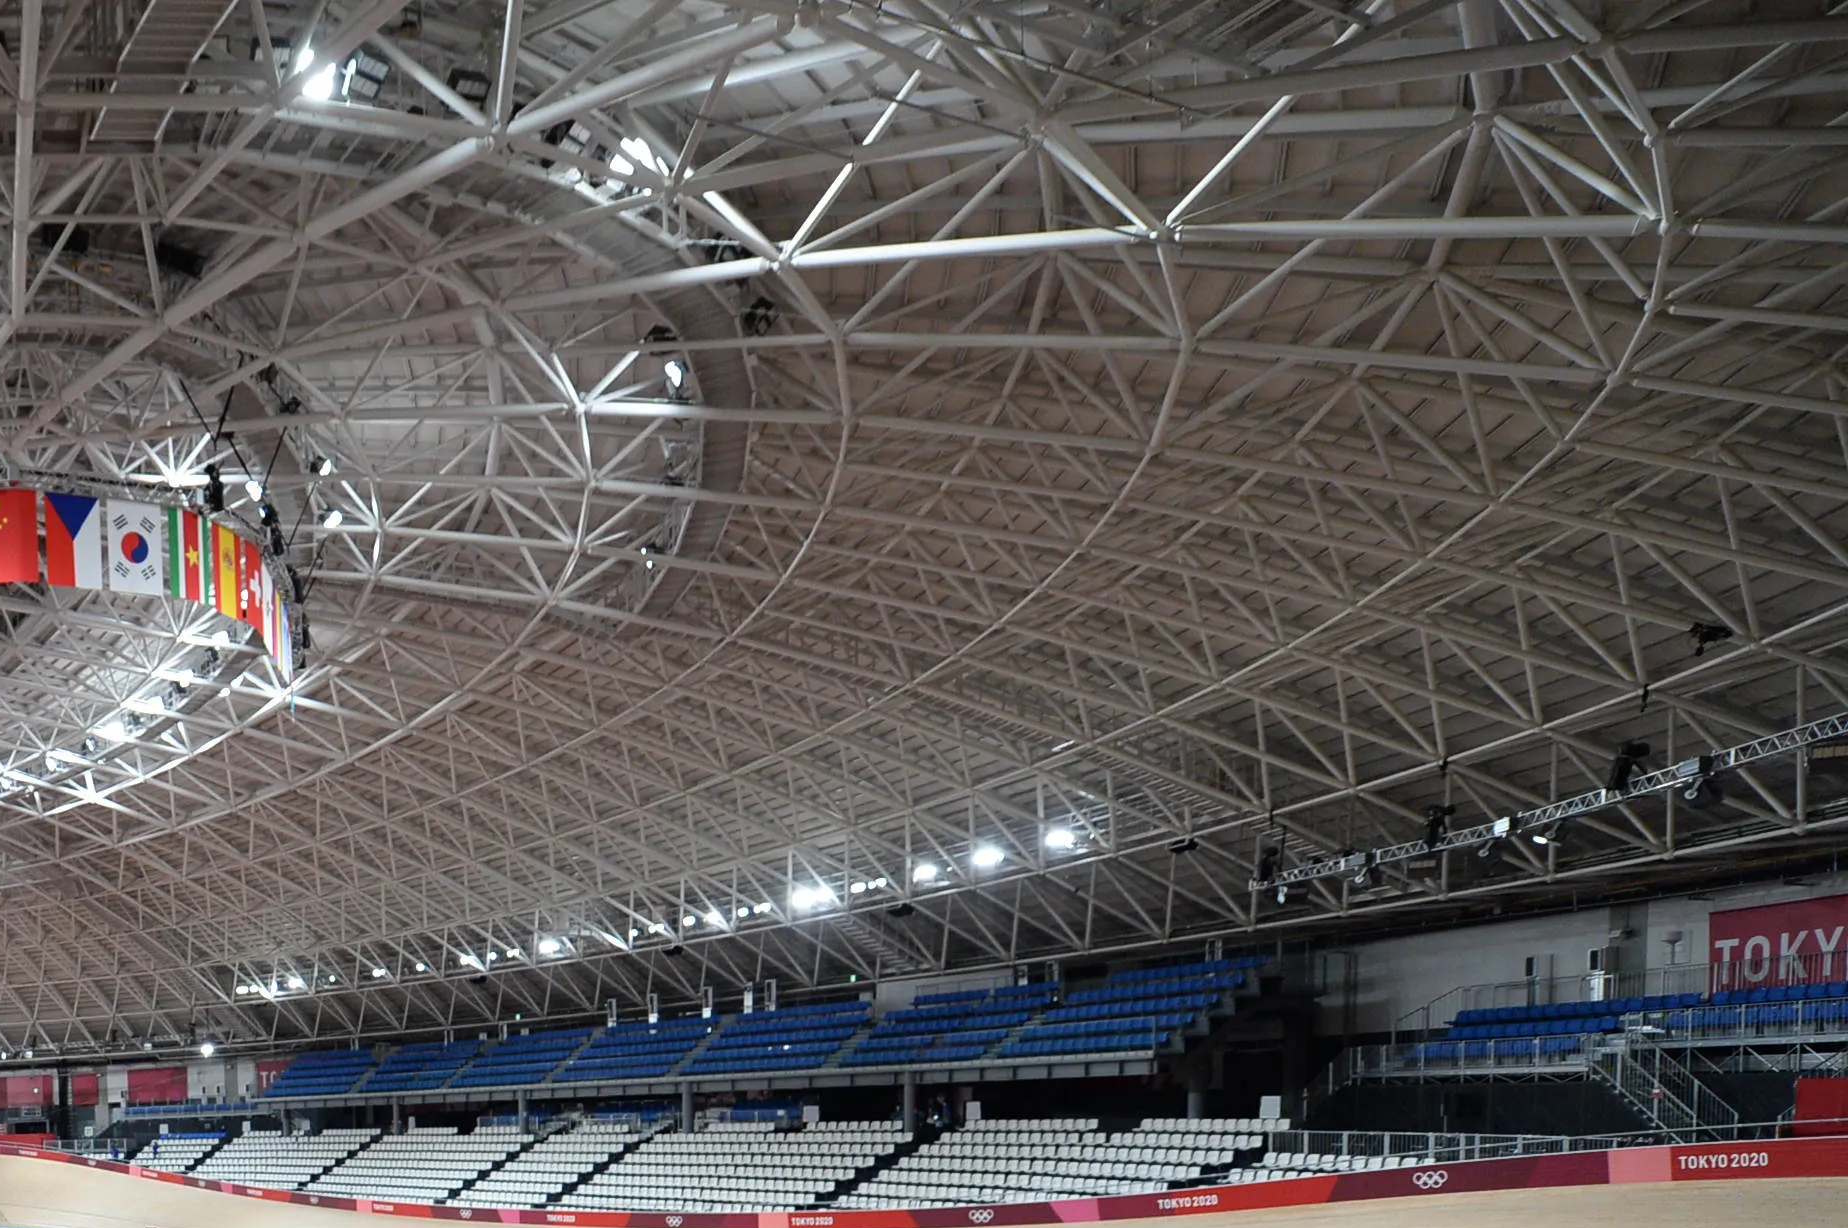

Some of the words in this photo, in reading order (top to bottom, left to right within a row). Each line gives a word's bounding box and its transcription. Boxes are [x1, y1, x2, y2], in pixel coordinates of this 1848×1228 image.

[1714, 926, 1848, 985] TOKY
[1678, 1154, 1728, 1170] TOKYO
[1730, 1152, 1769, 1168] 2020
[1157, 1197, 1191, 1209] TOKYO
[1192, 1194, 1219, 1207] 2020
